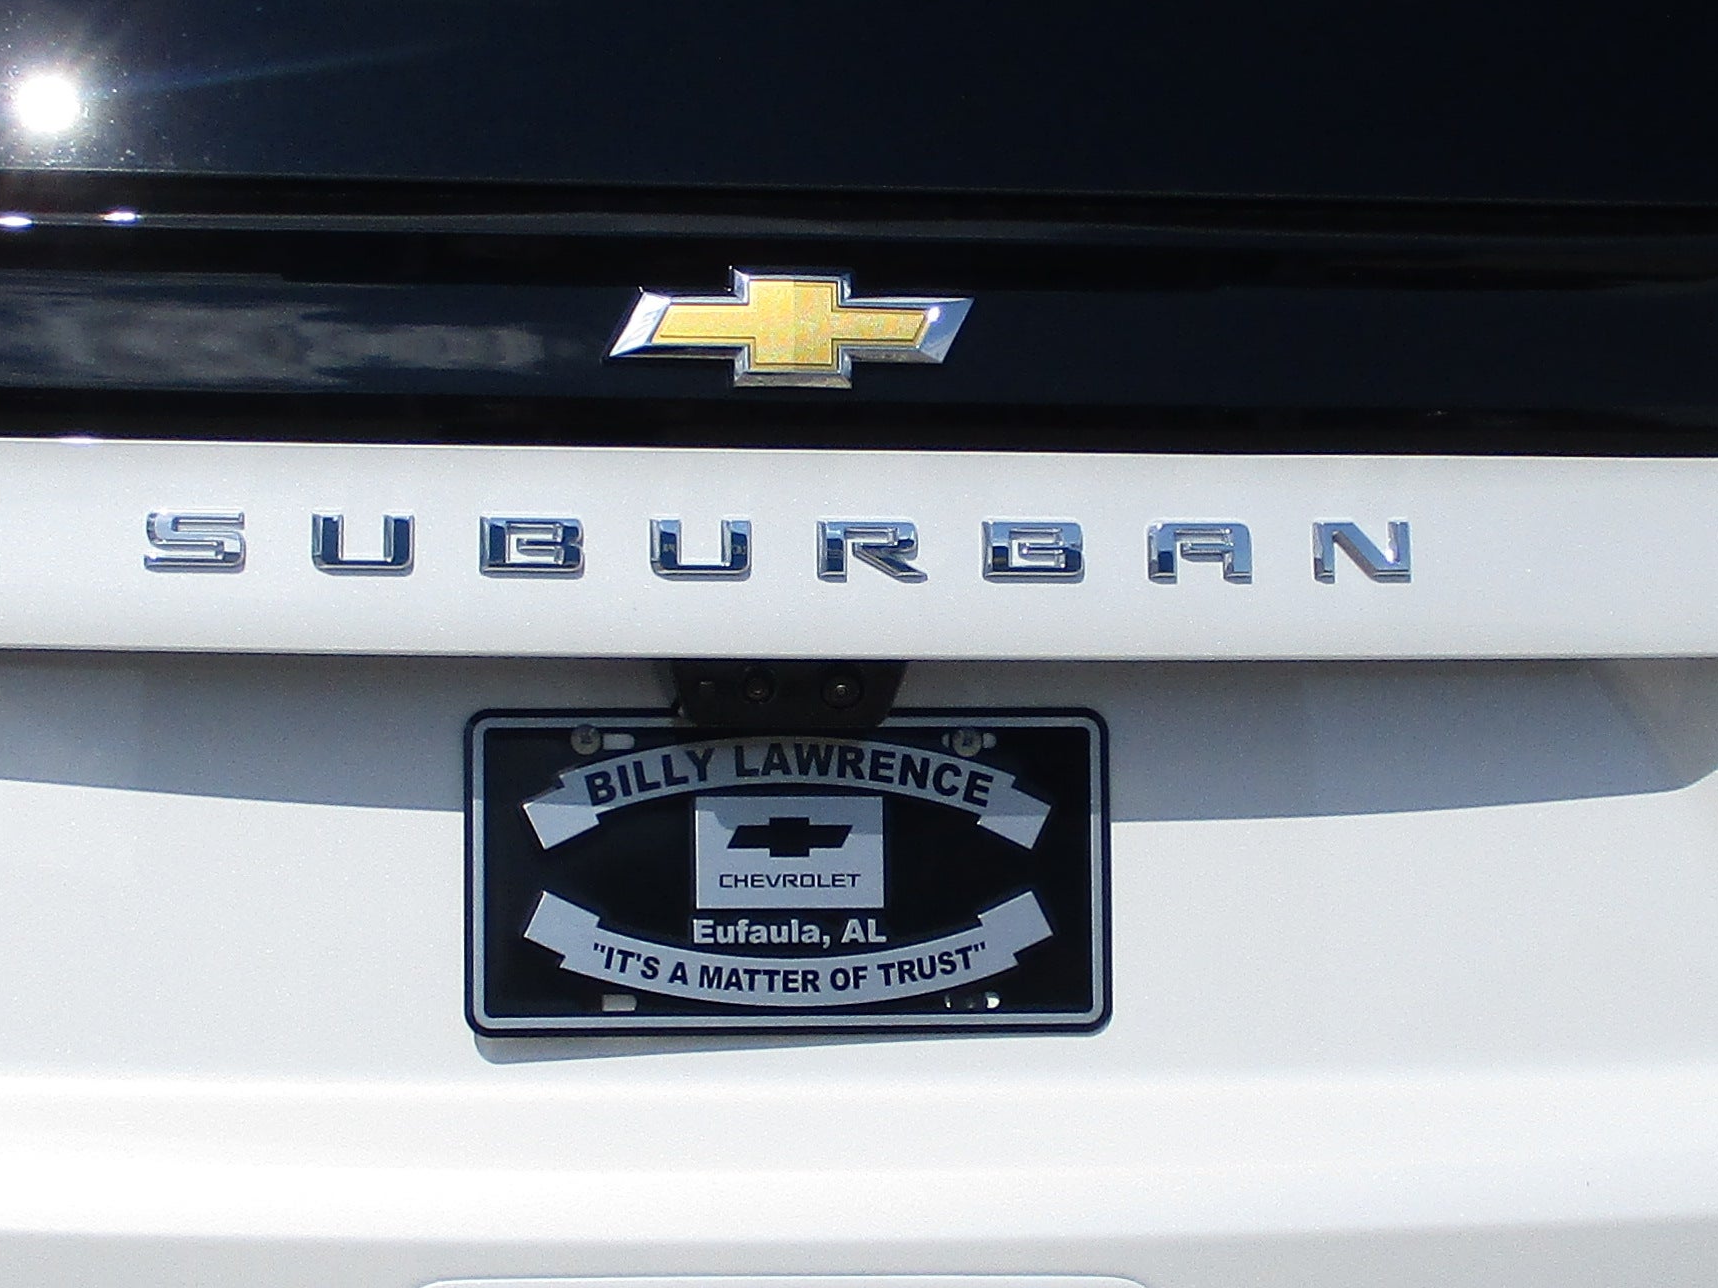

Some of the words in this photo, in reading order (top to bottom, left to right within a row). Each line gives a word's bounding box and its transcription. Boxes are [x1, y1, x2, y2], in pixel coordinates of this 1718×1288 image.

[143, 512, 1414, 584] SUBURBAN
[584, 747, 715, 807] BILLY
[735, 741, 994, 808] LAWRENCE
[719, 872, 862, 889] CHEVROLET
[692, 918, 831, 949] Eufaula,
[840, 919, 888, 944] AL
[592, 942, 661, 981] "IT'S
[668, 961, 689, 986] A
[698, 965, 820, 993] MATTER
[829, 965, 868, 991] OF
[876, 941, 987, 988] TRUST"
